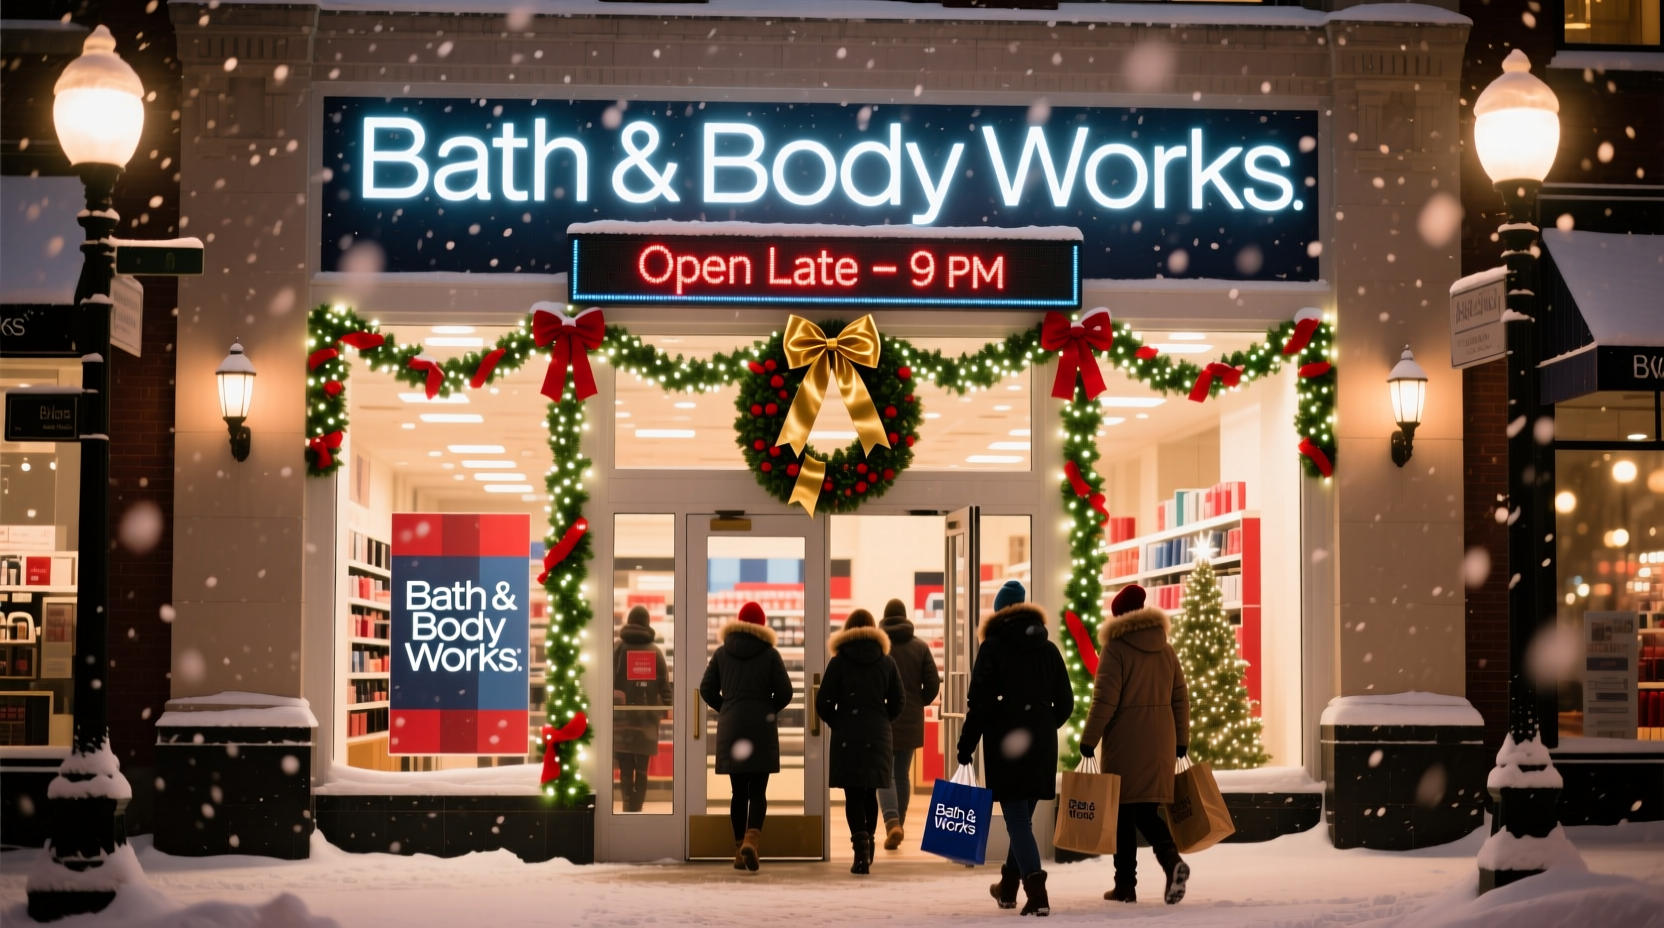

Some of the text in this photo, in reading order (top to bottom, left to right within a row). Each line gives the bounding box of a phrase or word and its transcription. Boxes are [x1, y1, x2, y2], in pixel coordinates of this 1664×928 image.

[362, 116, 1304, 225] Bath & Body Works.
[638, 244, 752, 295] Open
[768, 246, 859, 286] Late
[909, 250, 936, 287] 9
[947, 255, 1004, 290] PM
[406, 580, 518, 611] Bath &
[412, 611, 507, 649] Body
